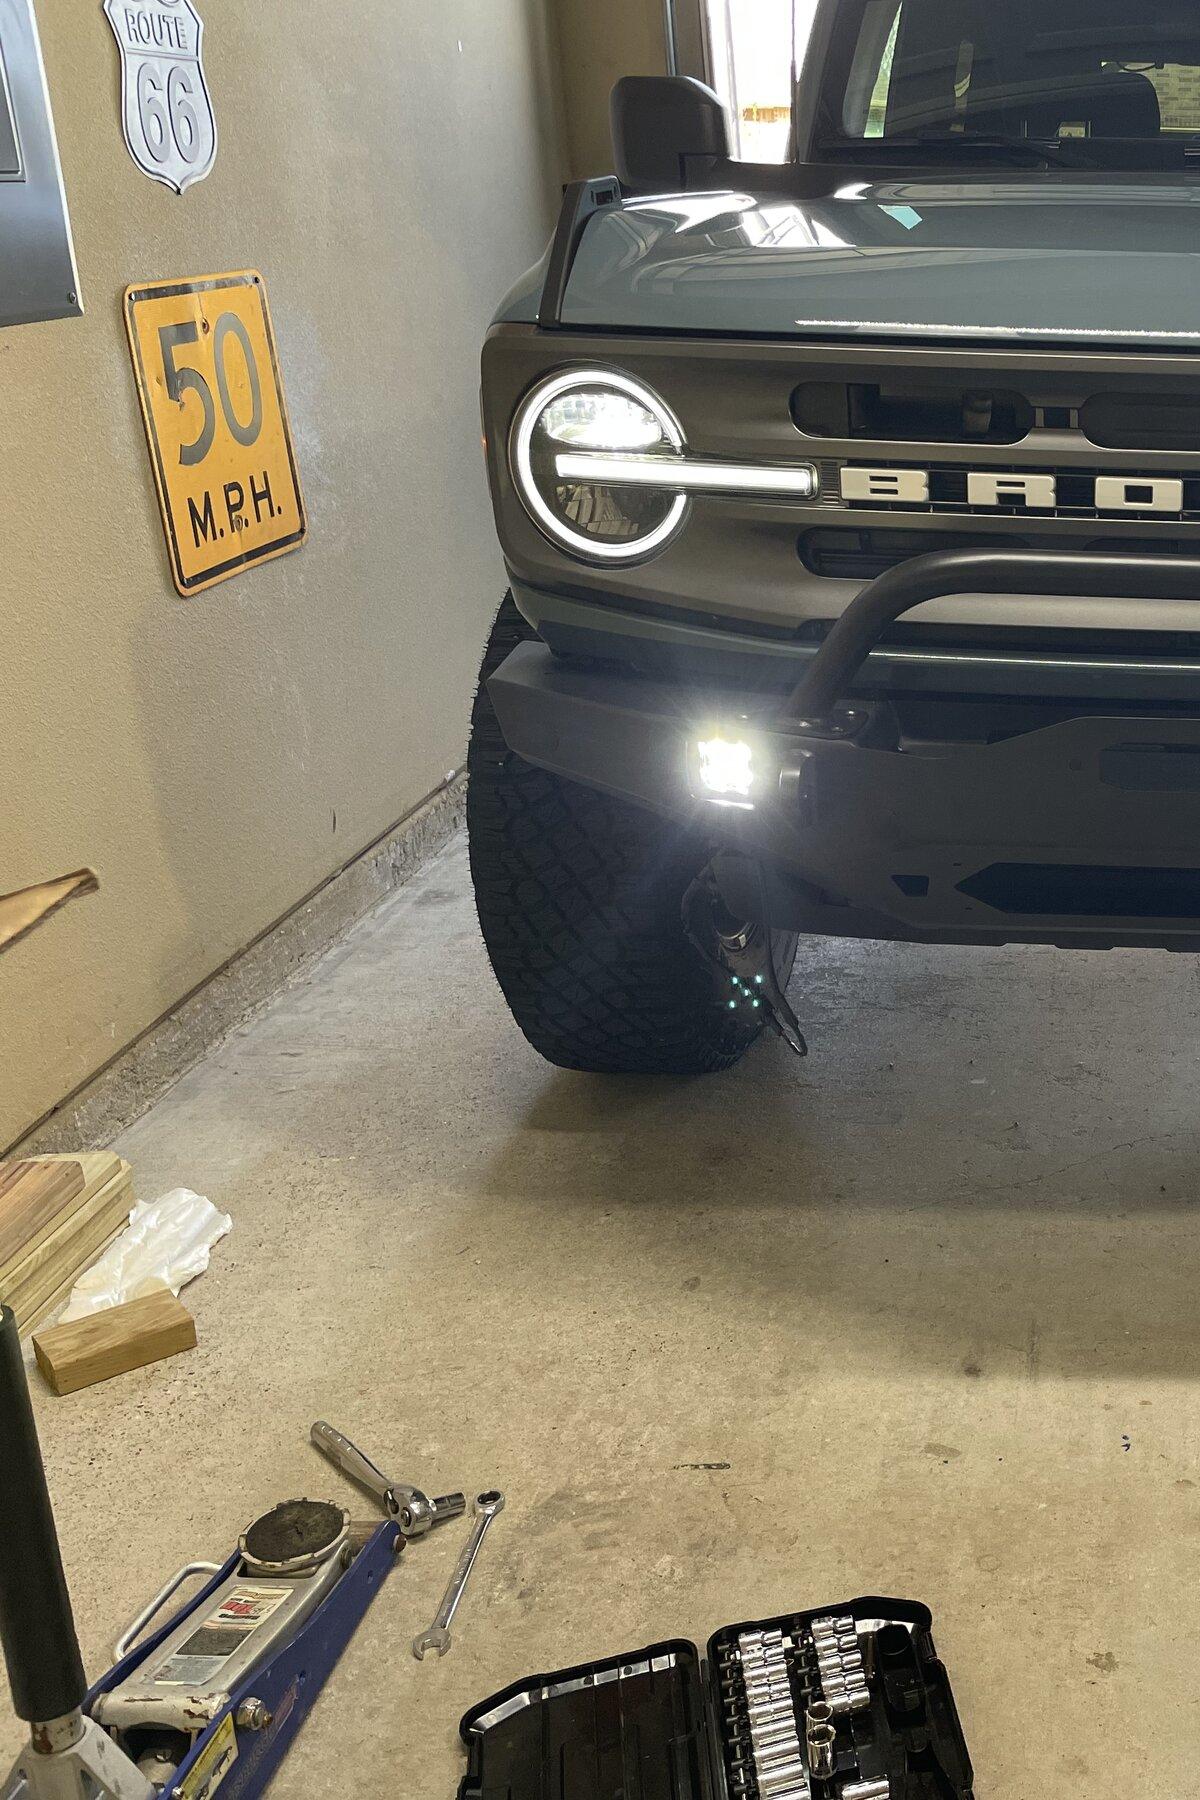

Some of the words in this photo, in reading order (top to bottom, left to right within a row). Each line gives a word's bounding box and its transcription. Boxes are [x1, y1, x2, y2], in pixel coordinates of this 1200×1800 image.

[124, 8, 188, 49] ROUTE
[137, 62, 200, 164] 66
[158, 311, 263, 466] 50
[187, 471, 282, 549] M.P.H.
